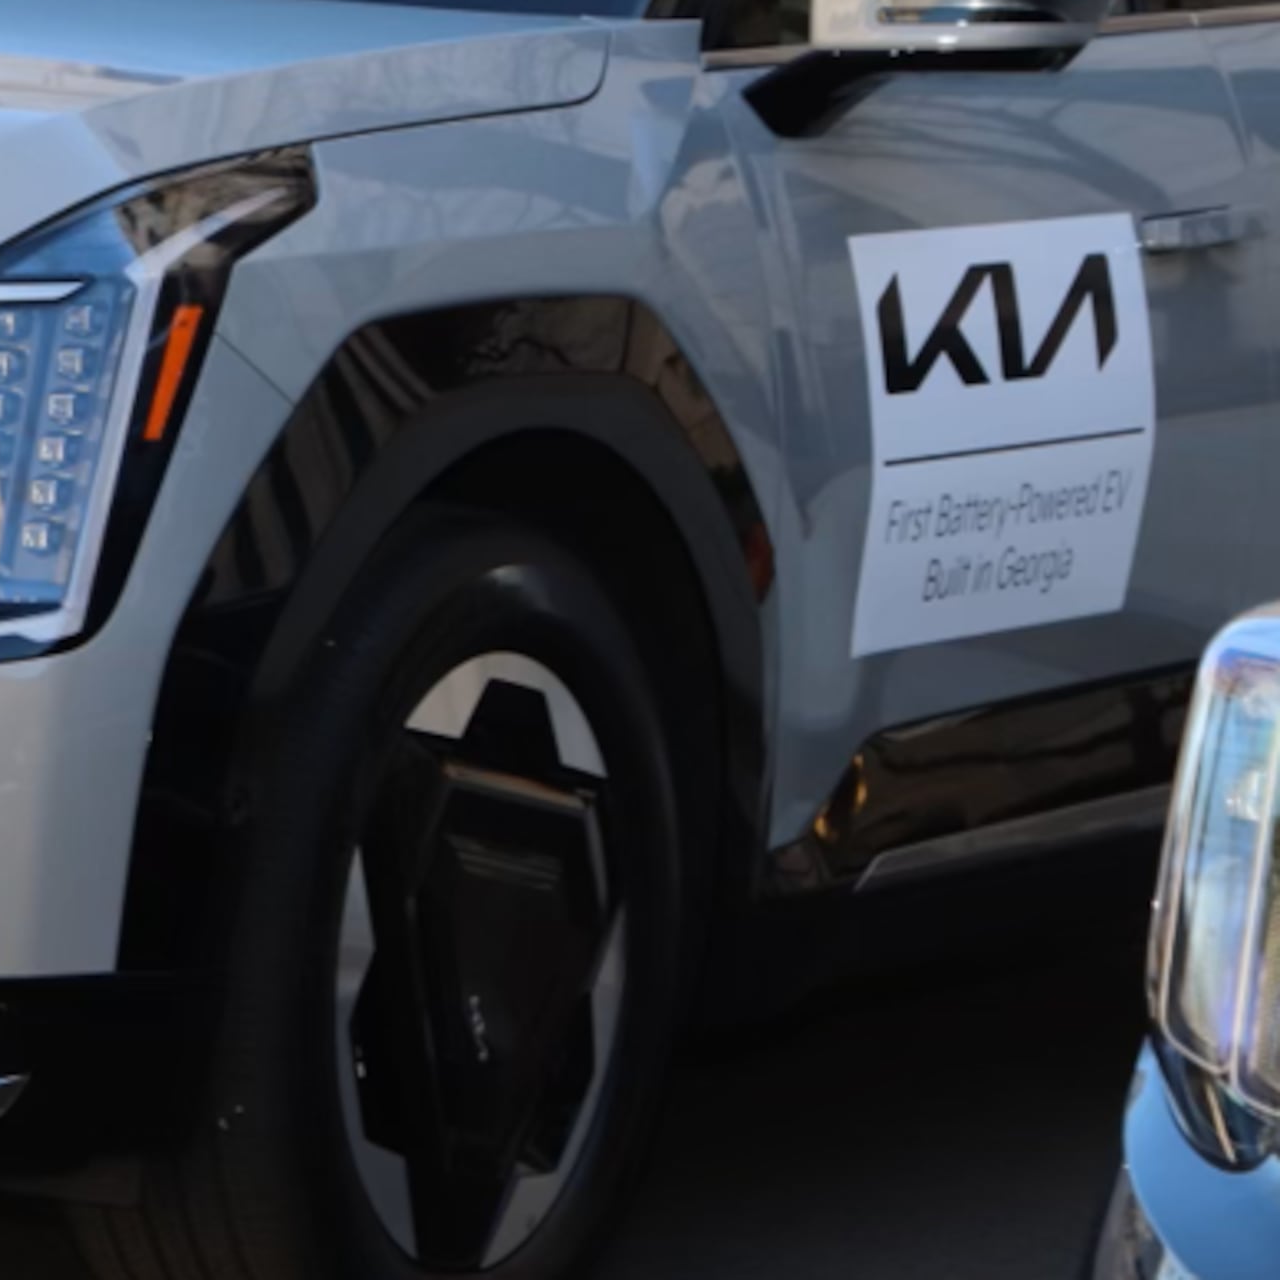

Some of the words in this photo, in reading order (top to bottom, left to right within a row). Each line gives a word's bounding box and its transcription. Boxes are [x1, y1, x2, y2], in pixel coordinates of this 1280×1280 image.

[876, 252, 1118, 394] KIA
[884, 498, 932, 544] First
[934, 472, 1102, 540] Battery-Powered
[1101, 468, 1134, 514] EV
[921, 553, 972, 603] Built
[971, 552, 993, 594] in
[996, 537, 1074, 595] Georgia
